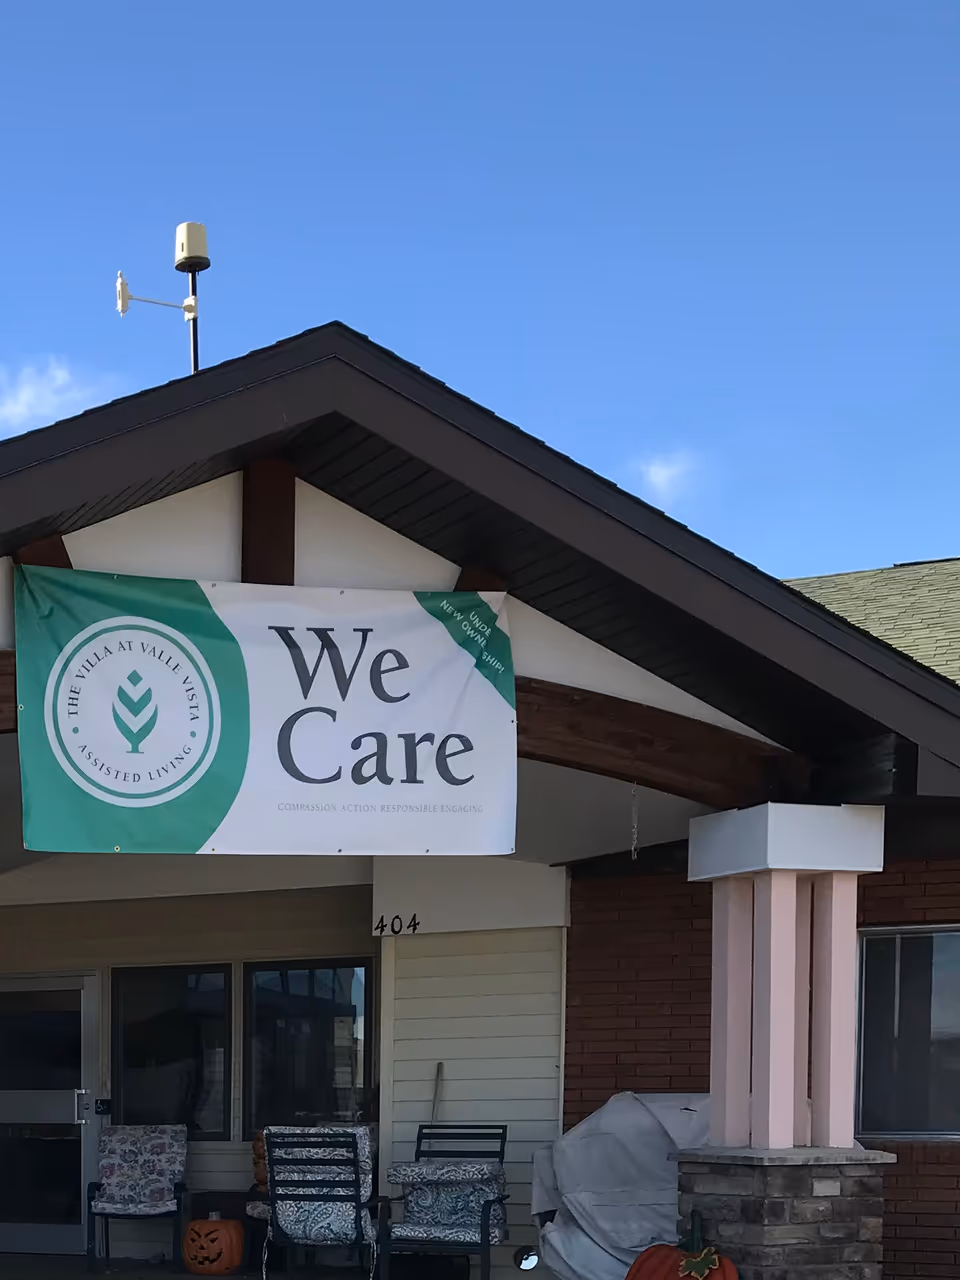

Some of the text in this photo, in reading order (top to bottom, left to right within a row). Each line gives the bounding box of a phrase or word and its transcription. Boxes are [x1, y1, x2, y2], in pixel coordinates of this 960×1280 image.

[440, 600, 505, 673] NEW OWNESHIP!
[470, 611, 491, 637] UNDE
[68, 641, 199, 721] THE VILLA AT VALLE VISTA
[268, 625, 411, 703] We
[78, 744, 191, 782] ASSISTED LIVING
[277, 706, 475, 786] Care
[277, 803, 483, 813] COMPASSION ACTION RESPONSIBLE ENGAGING
[374, 913, 420, 935] 404
